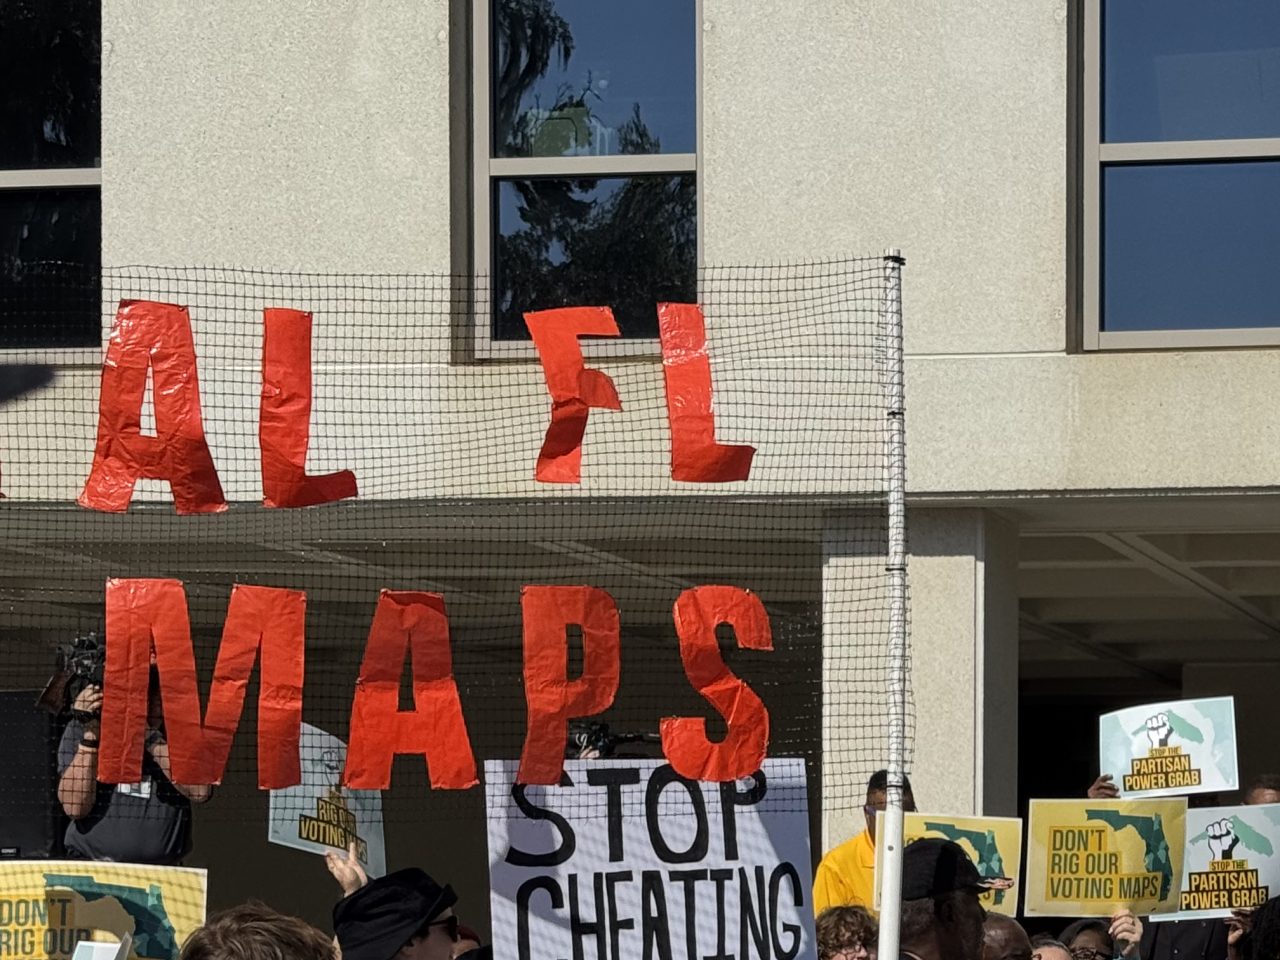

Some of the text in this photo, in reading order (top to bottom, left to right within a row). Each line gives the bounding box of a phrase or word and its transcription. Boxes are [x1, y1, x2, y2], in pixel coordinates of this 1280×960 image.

[77, 299, 757, 515] AL FL
[97, 578, 773, 790] MAPS
[1132, 755, 1189, 775] PARTISAN
[1124, 770, 1200, 791] POWER GRAB
[318, 800, 338, 823] RIG
[504, 763, 768, 867] STOP
[301, 816, 346, 848] VOTING
[1052, 829, 1106, 852] DON'T
[1050, 852, 1119, 875] RIG OUR
[1211, 860, 1245, 871] STOP THE
[1050, 875, 1159, 899] VOTING MAPS
[1190, 871, 1257, 892] PARTISAN
[1181, 888, 1267, 910] POWER GRAB
[0, 898, 72, 927] DON'T
